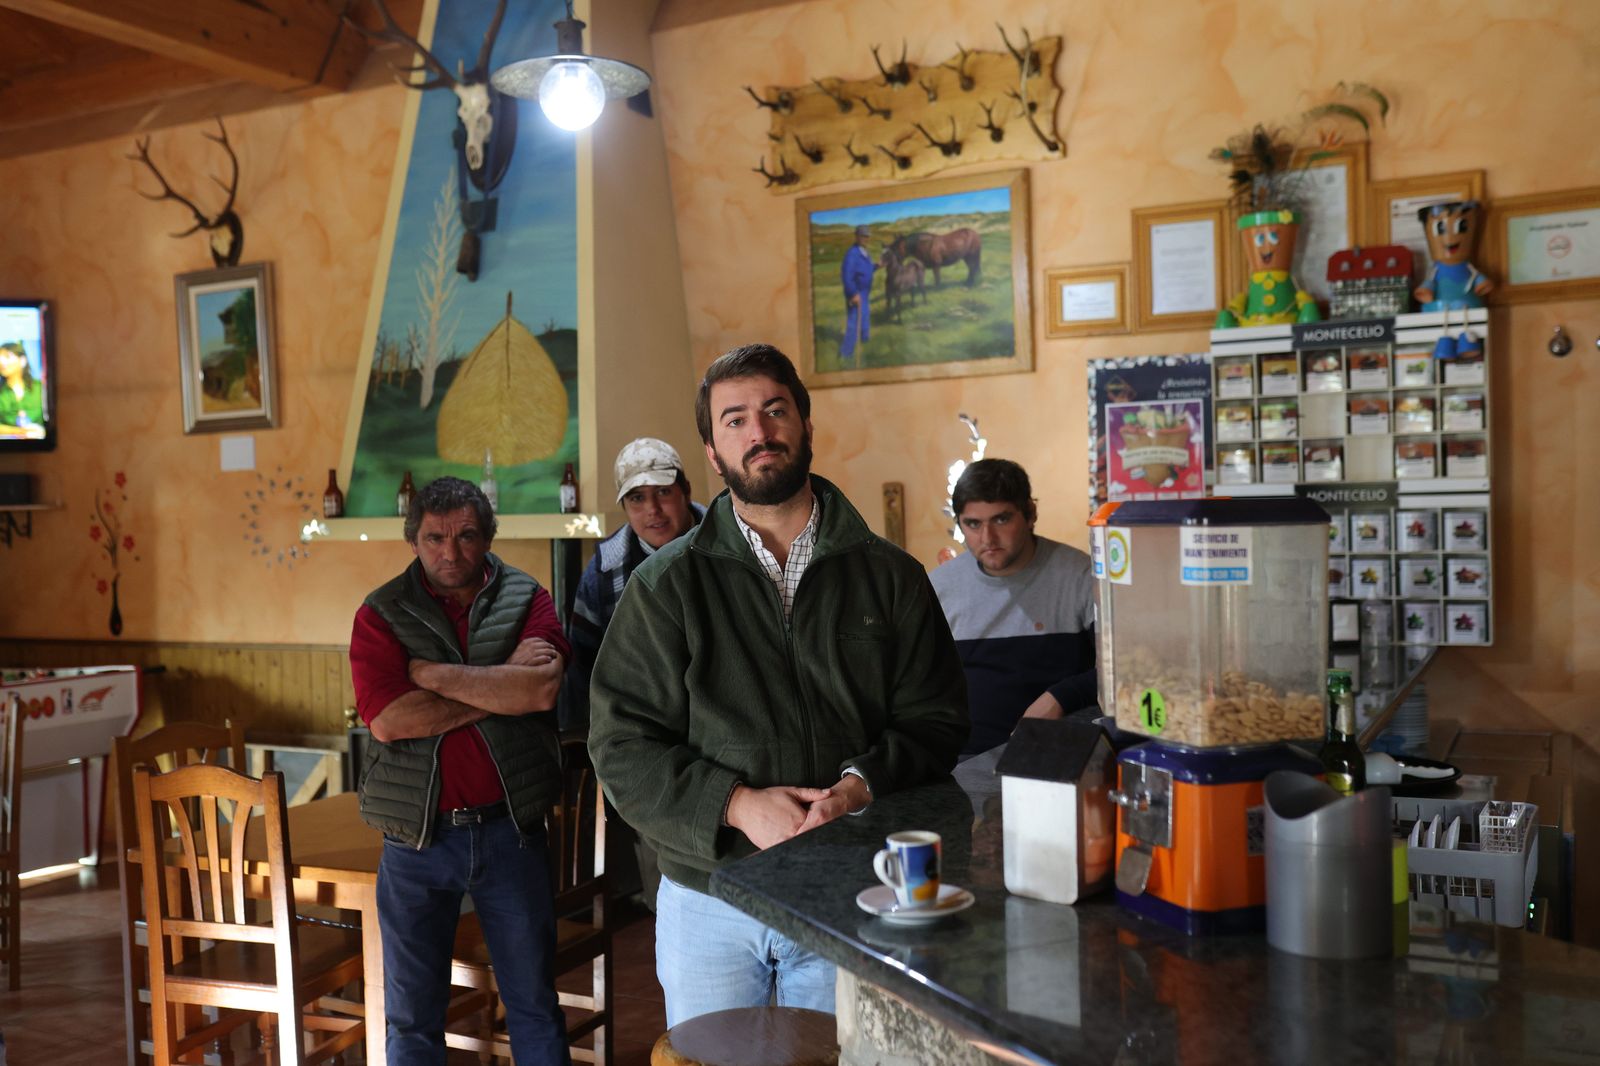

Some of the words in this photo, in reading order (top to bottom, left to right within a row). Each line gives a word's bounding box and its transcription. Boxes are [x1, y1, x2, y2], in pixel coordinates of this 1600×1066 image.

[1303, 324, 1384, 342] MONTECELIO
[1193, 534, 1228, 543] SERVICIO
[1230, 534, 1239, 543] DE
[1184, 548, 1248, 558] MANTENIMIENTO
[1142, 692, 1162, 728] 1€
